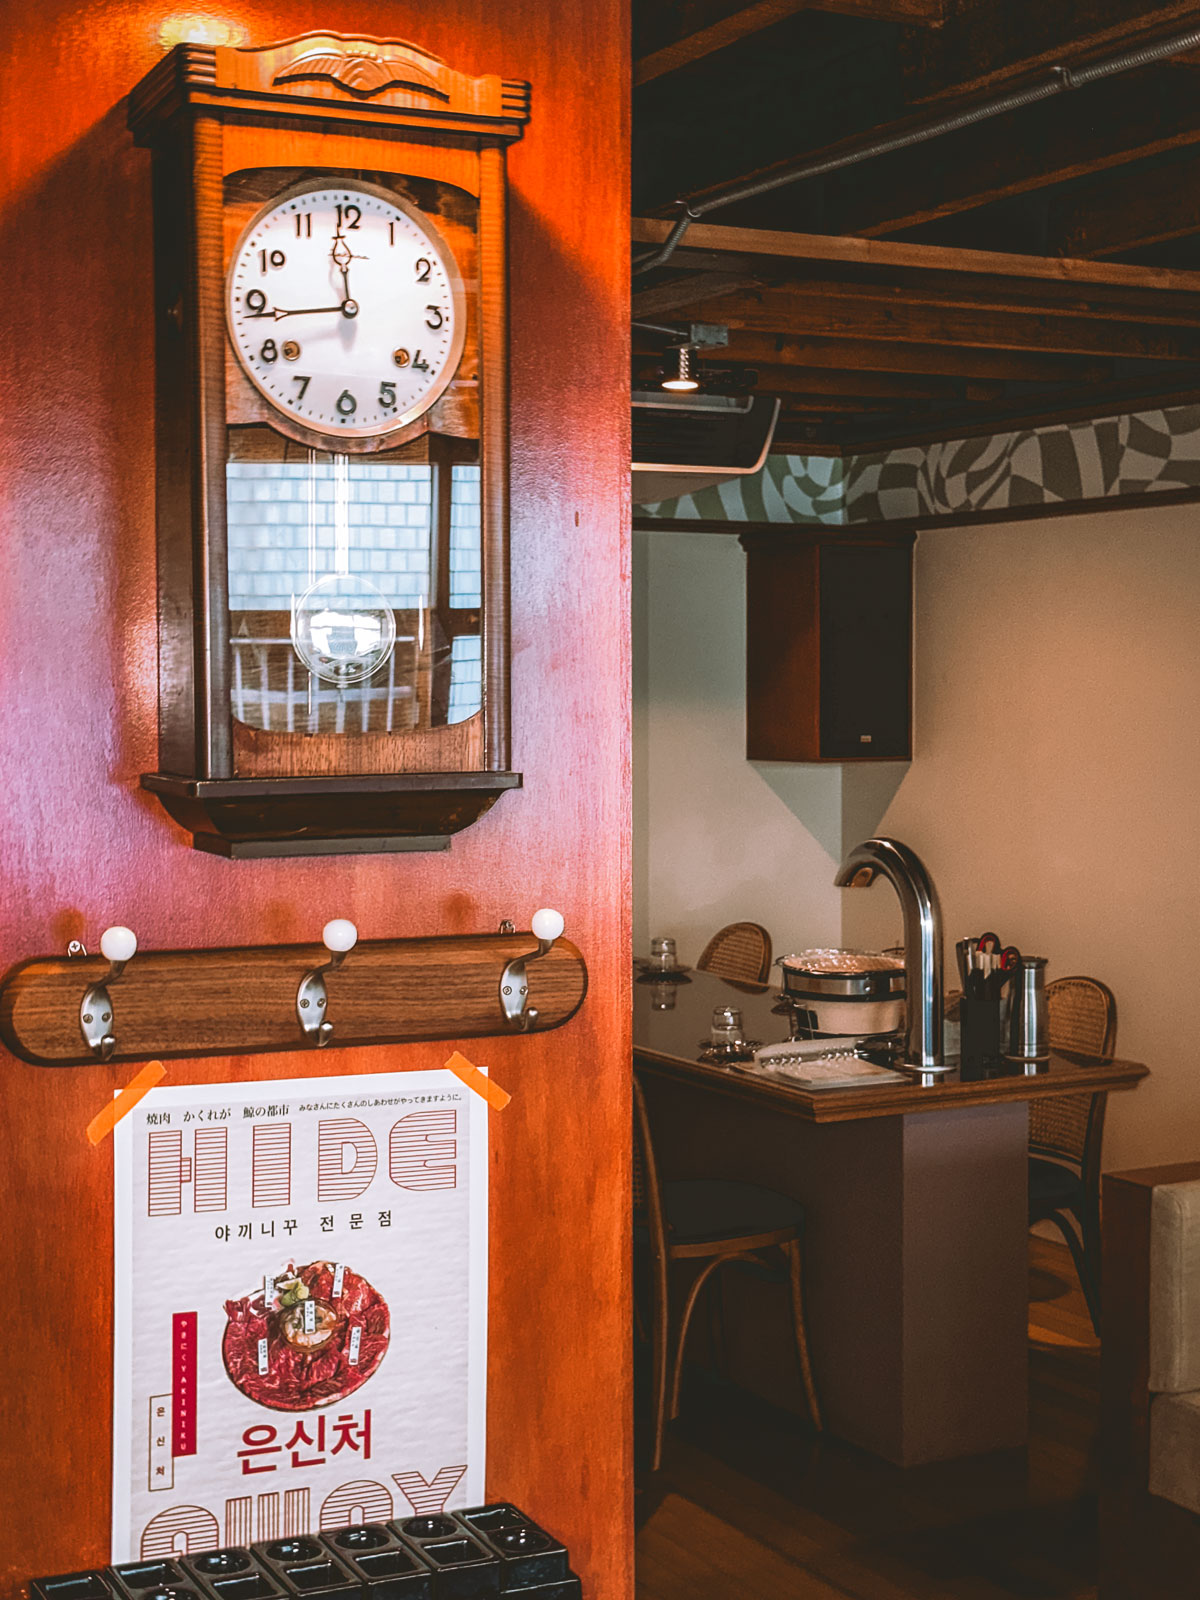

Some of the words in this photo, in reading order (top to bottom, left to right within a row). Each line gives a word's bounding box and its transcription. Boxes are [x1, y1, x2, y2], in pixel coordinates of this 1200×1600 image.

[294, 212, 312, 238] 11
[334, 204, 362, 230] 12
[388, 221, 396, 247] 1
[259, 249, 286, 273] 10
[415, 258, 432, 283] 2
[246, 288, 267, 315] 9
[425, 304, 444, 330] 3
[260, 338, 278, 364] 8
[411, 349, 430, 373] 4
[293, 375, 312, 400] 7
[377, 381, 397, 408] 5
[336, 389, 358, 416] 6
[146, 1112, 171, 1125] 焼肉
[183, 1108, 232, 1122] かくれが
[148, 1109, 457, 1217] HIDE
[214, 1218, 299, 1243] 야끼니꾸
[319, 1210, 393, 1233] 전문점
[180, 1365, 188, 1451] YAKINIKU
[237, 1409, 372, 1476] 은신처
